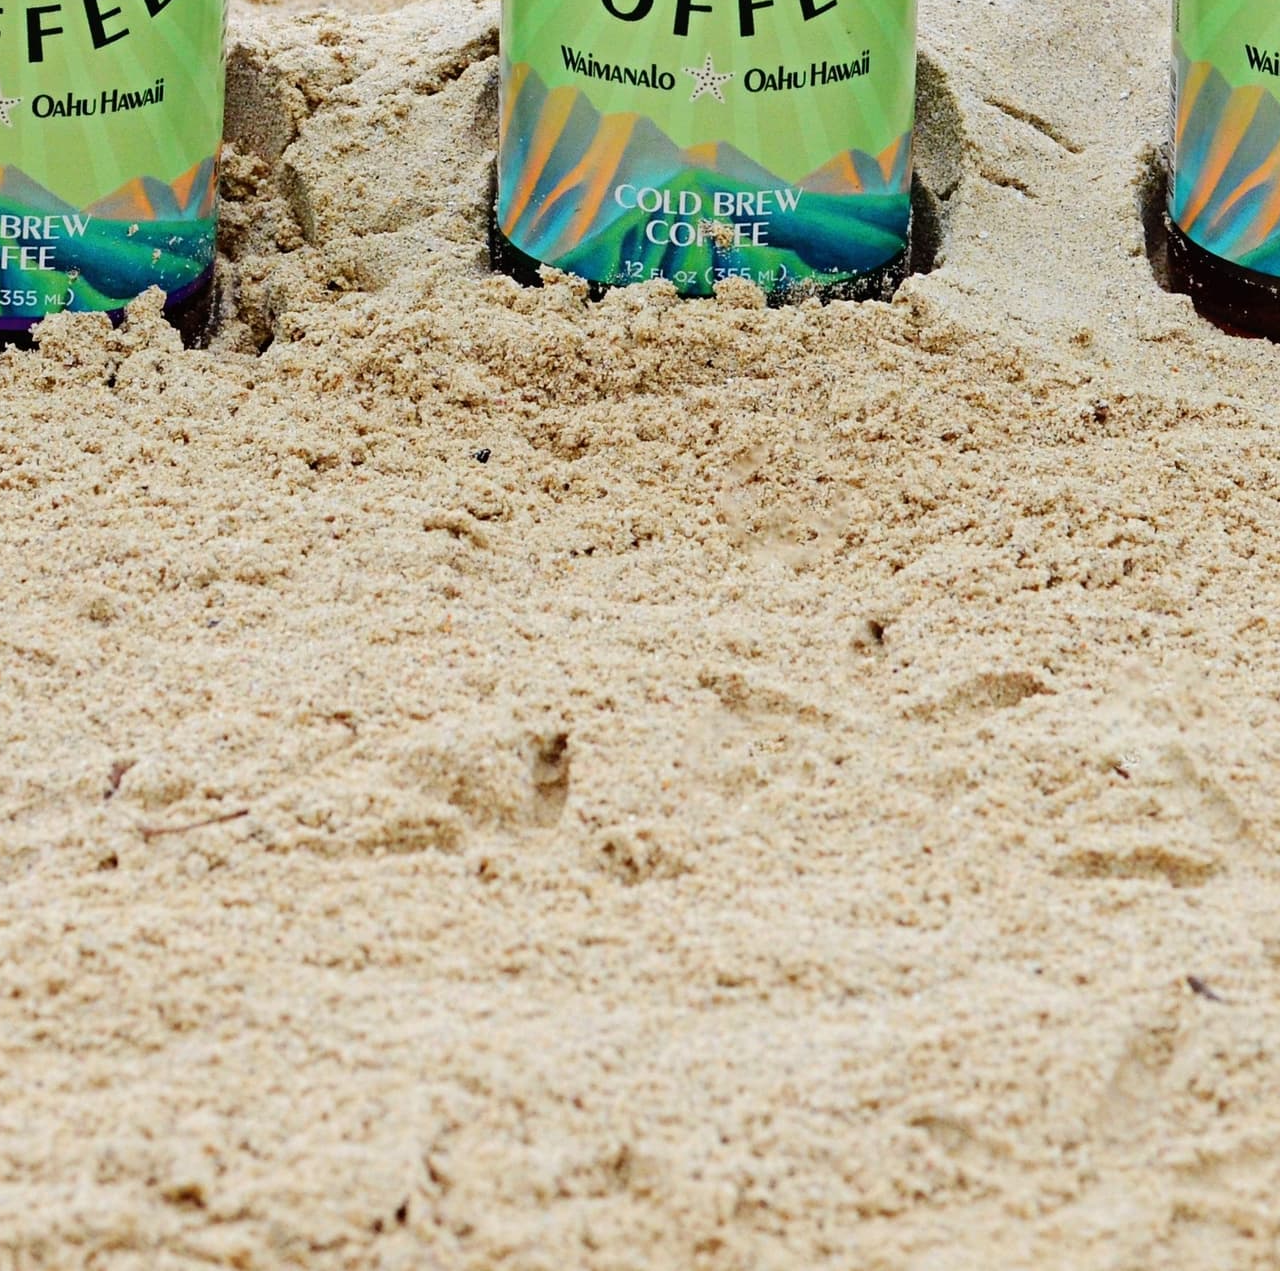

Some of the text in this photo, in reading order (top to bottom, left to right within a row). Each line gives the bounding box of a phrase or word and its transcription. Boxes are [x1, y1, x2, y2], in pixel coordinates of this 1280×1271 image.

[614, 184, 804, 216] COLD BREW
[0, 213, 91, 240] BREW
[646, 220, 769, 247] COFEE
[625, 260, 644, 278] 12
[675, 270, 697, 284] OZ
[44, 288, 74, 305] ML)
